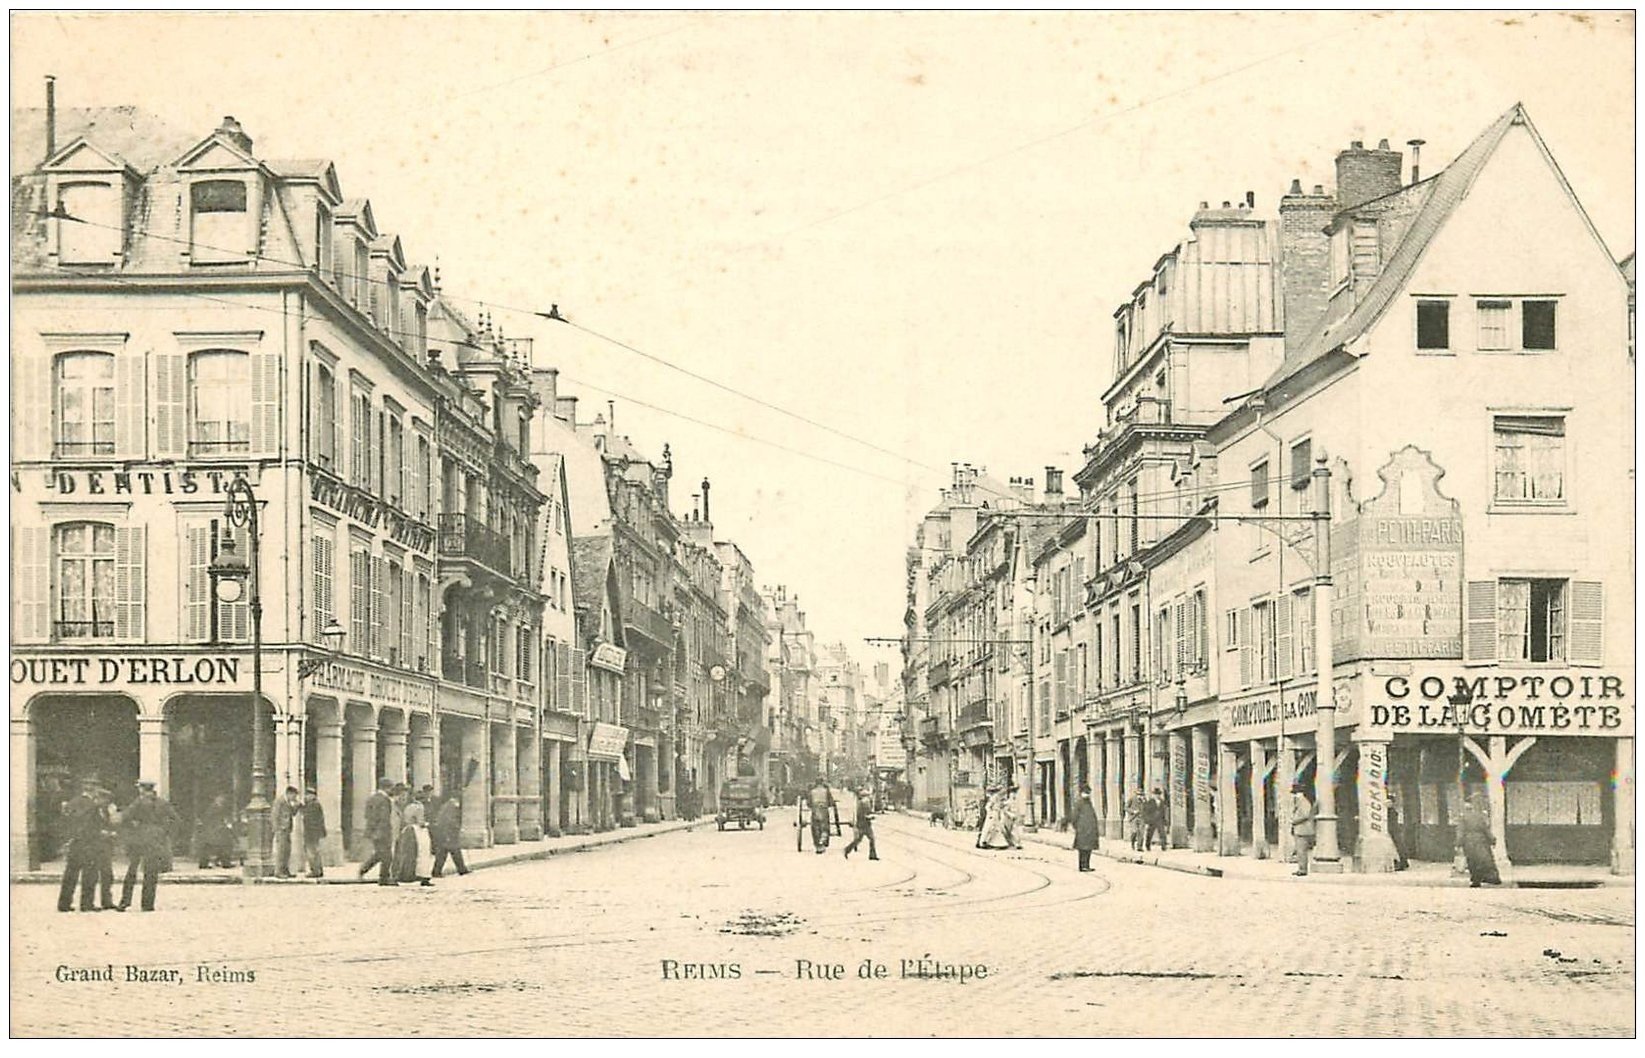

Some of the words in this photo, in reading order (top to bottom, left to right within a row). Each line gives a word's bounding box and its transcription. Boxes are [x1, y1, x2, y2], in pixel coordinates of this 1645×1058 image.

[99, 658, 240, 683] D'ERLON
[1385, 676, 1625, 699] COMPTOIR
[1371, 704, 1411, 727] DE
